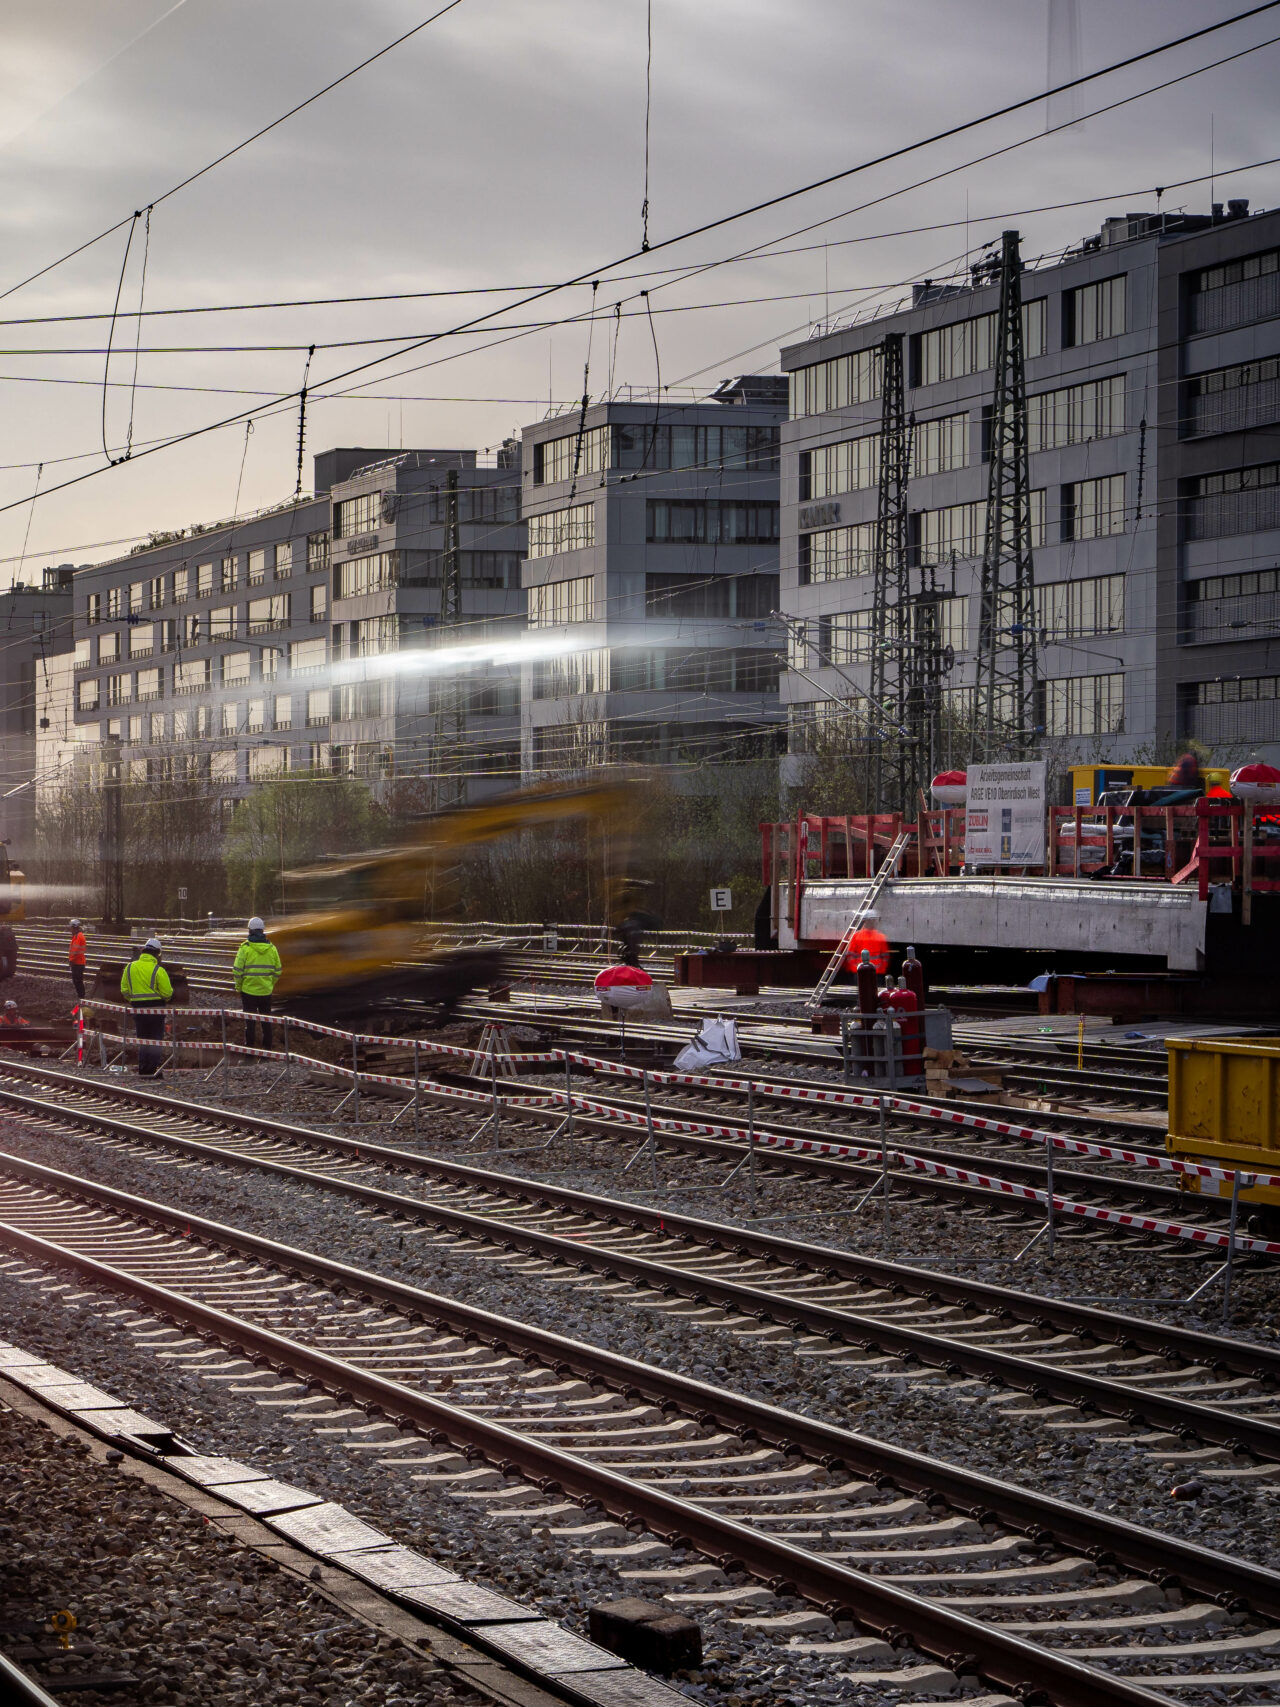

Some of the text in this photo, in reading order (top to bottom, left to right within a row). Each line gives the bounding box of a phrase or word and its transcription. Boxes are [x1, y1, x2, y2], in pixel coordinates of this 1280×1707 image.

[979, 767, 1031, 784] Arbeitsgemeinschaft
[178, 888, 187, 898] 10
[715, 891, 726, 907] E
